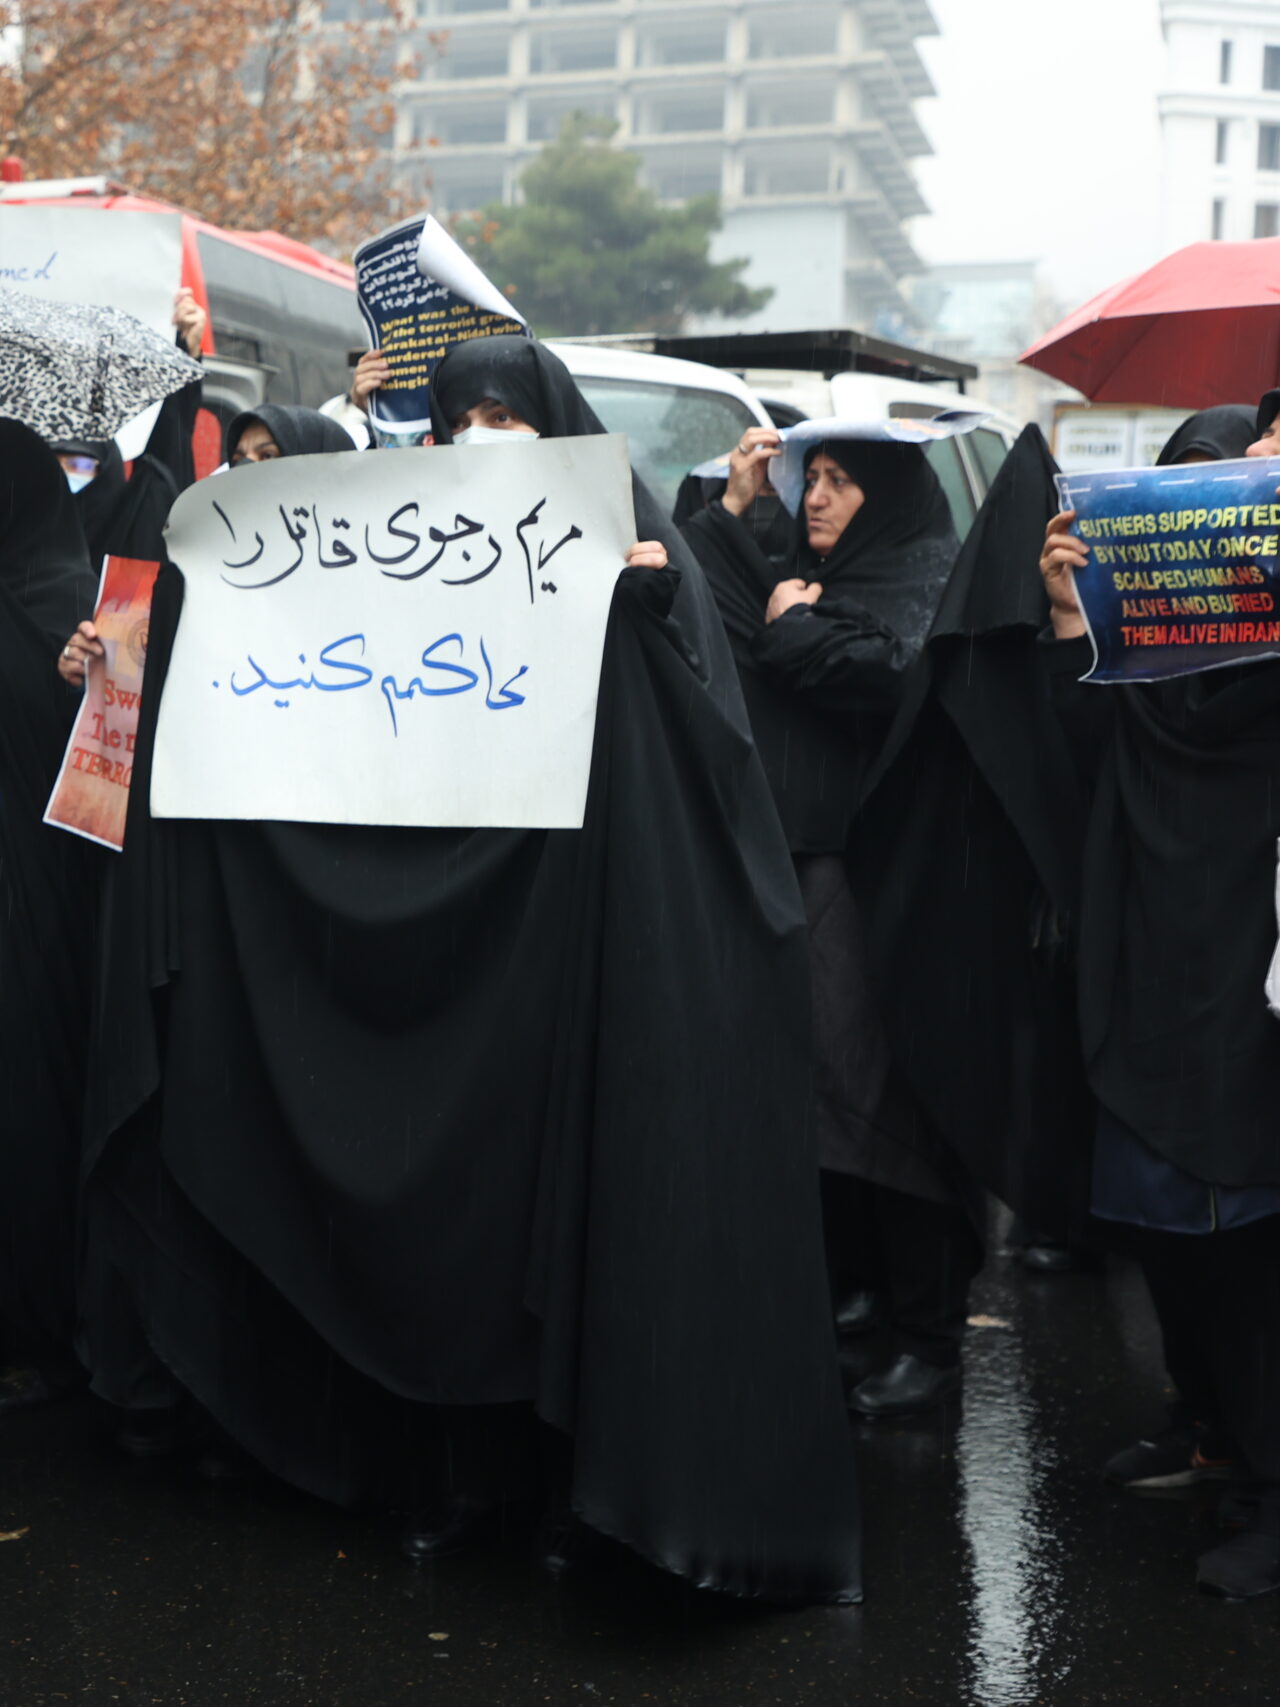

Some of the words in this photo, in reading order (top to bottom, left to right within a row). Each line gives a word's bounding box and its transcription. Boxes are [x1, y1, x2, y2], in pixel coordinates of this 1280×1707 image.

[418, 310, 446, 321] was
[451, 304, 469, 316] the
[383, 336, 433, 352] arakat
[493, 323, 522, 335] who
[393, 327, 416, 339] the
[420, 316, 476, 333] terrorist
[389, 364, 427, 377] omen
[212, 500, 264, 569] را
[220, 503, 357, 590] قاتل
[366, 502, 503, 586] رجوی
[517, 497, 582, 604] مریم
[1094, 545, 1116, 564] BY
[1115, 542, 1150, 564] YOU
[1217, 535, 1279, 558] ONCE
[1113, 569, 1188, 591] SCALPED
[1189, 566, 1265, 587] HUMANS
[1122, 598, 1171, 618] ALIVE
[1172, 596, 1209, 615] AND
[1208, 592, 1275, 614] BURIED
[1121, 625, 1168, 647] THEM
[1169, 623, 1218, 645] ALIVE
